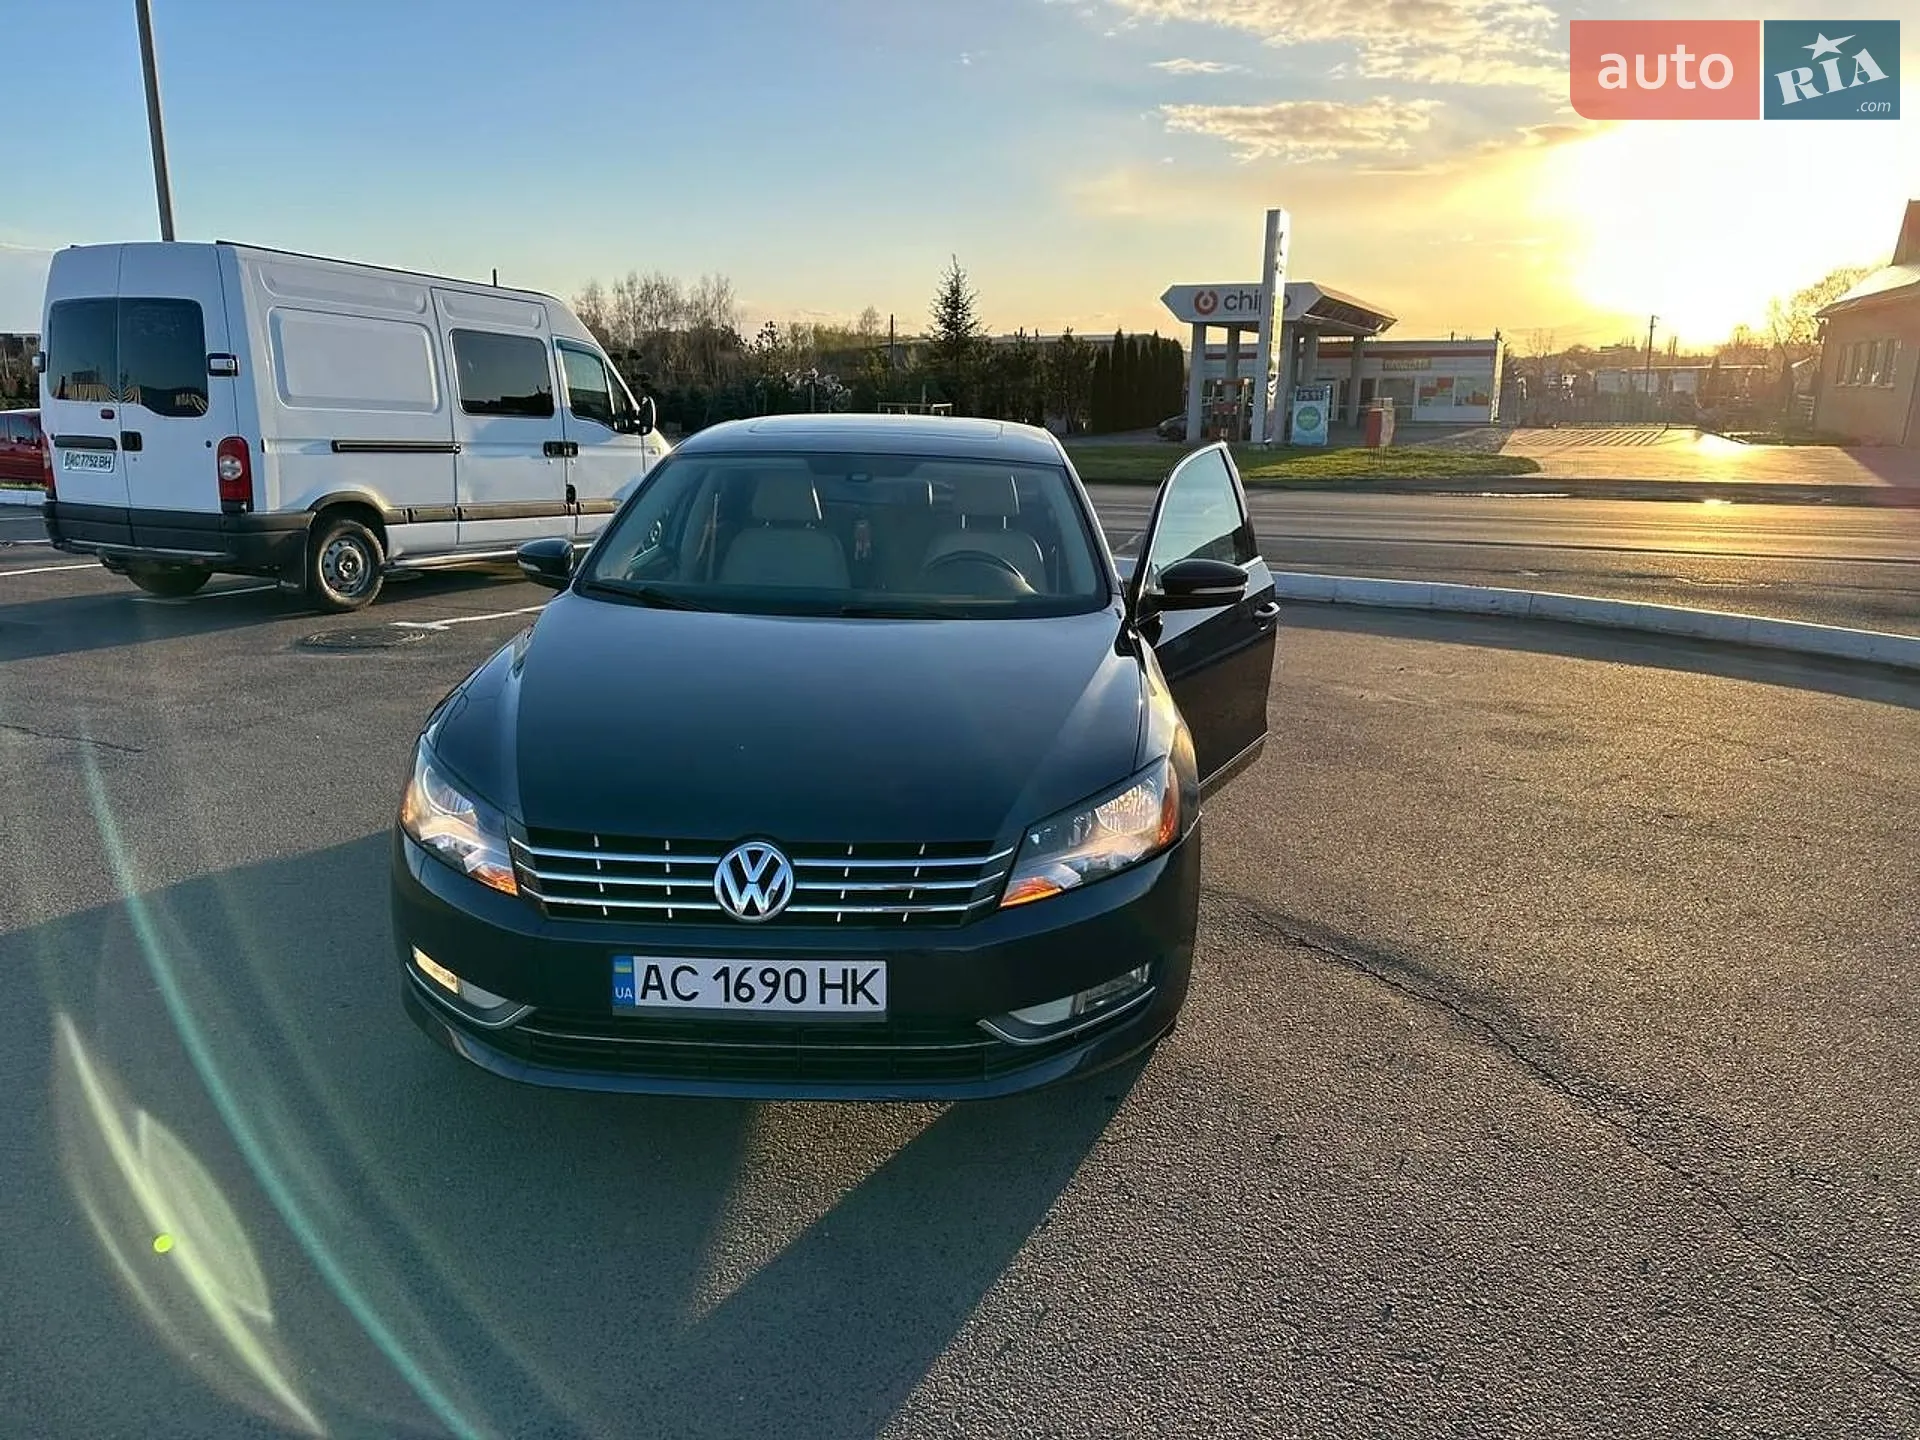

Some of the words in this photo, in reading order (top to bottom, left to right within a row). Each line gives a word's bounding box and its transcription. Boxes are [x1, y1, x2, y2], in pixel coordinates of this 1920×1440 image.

[1223, 289, 1291, 316] chio
[615, 986, 633, 999] UA
[640, 964, 699, 1001] AC
[712, 965, 807, 1004] 1690
[818, 967, 880, 1005] HK
